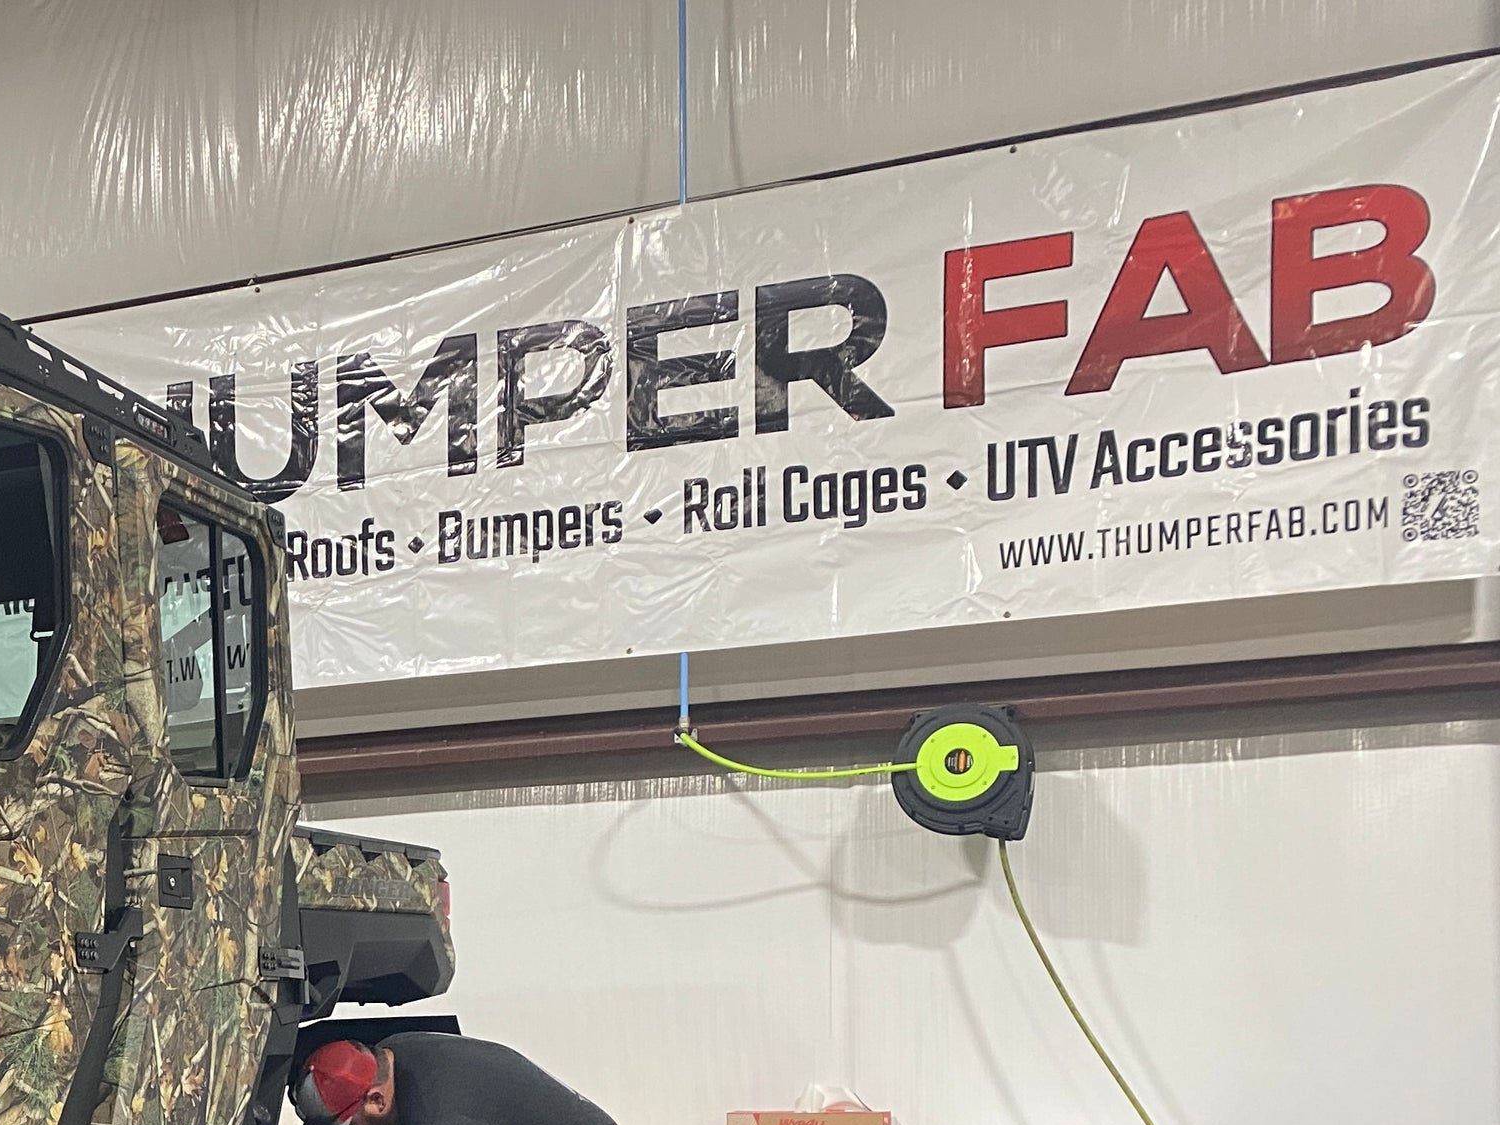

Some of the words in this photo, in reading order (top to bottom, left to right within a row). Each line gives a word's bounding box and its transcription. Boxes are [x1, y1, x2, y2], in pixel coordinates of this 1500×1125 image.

[944, 184, 1436, 410] FAB
[286, 516, 395, 583] Roofs
[438, 500, 624, 564] Bumpers
[683, 465, 767, 535] Roll
[783, 463, 927, 529] Cages
[987, 432, 1080, 502] UTV
[1090, 387, 1431, 490] Accessories
[1000, 496, 1390, 570] WWW.THUMPERFAB.COM
[334, 877, 413, 899] RANGER
